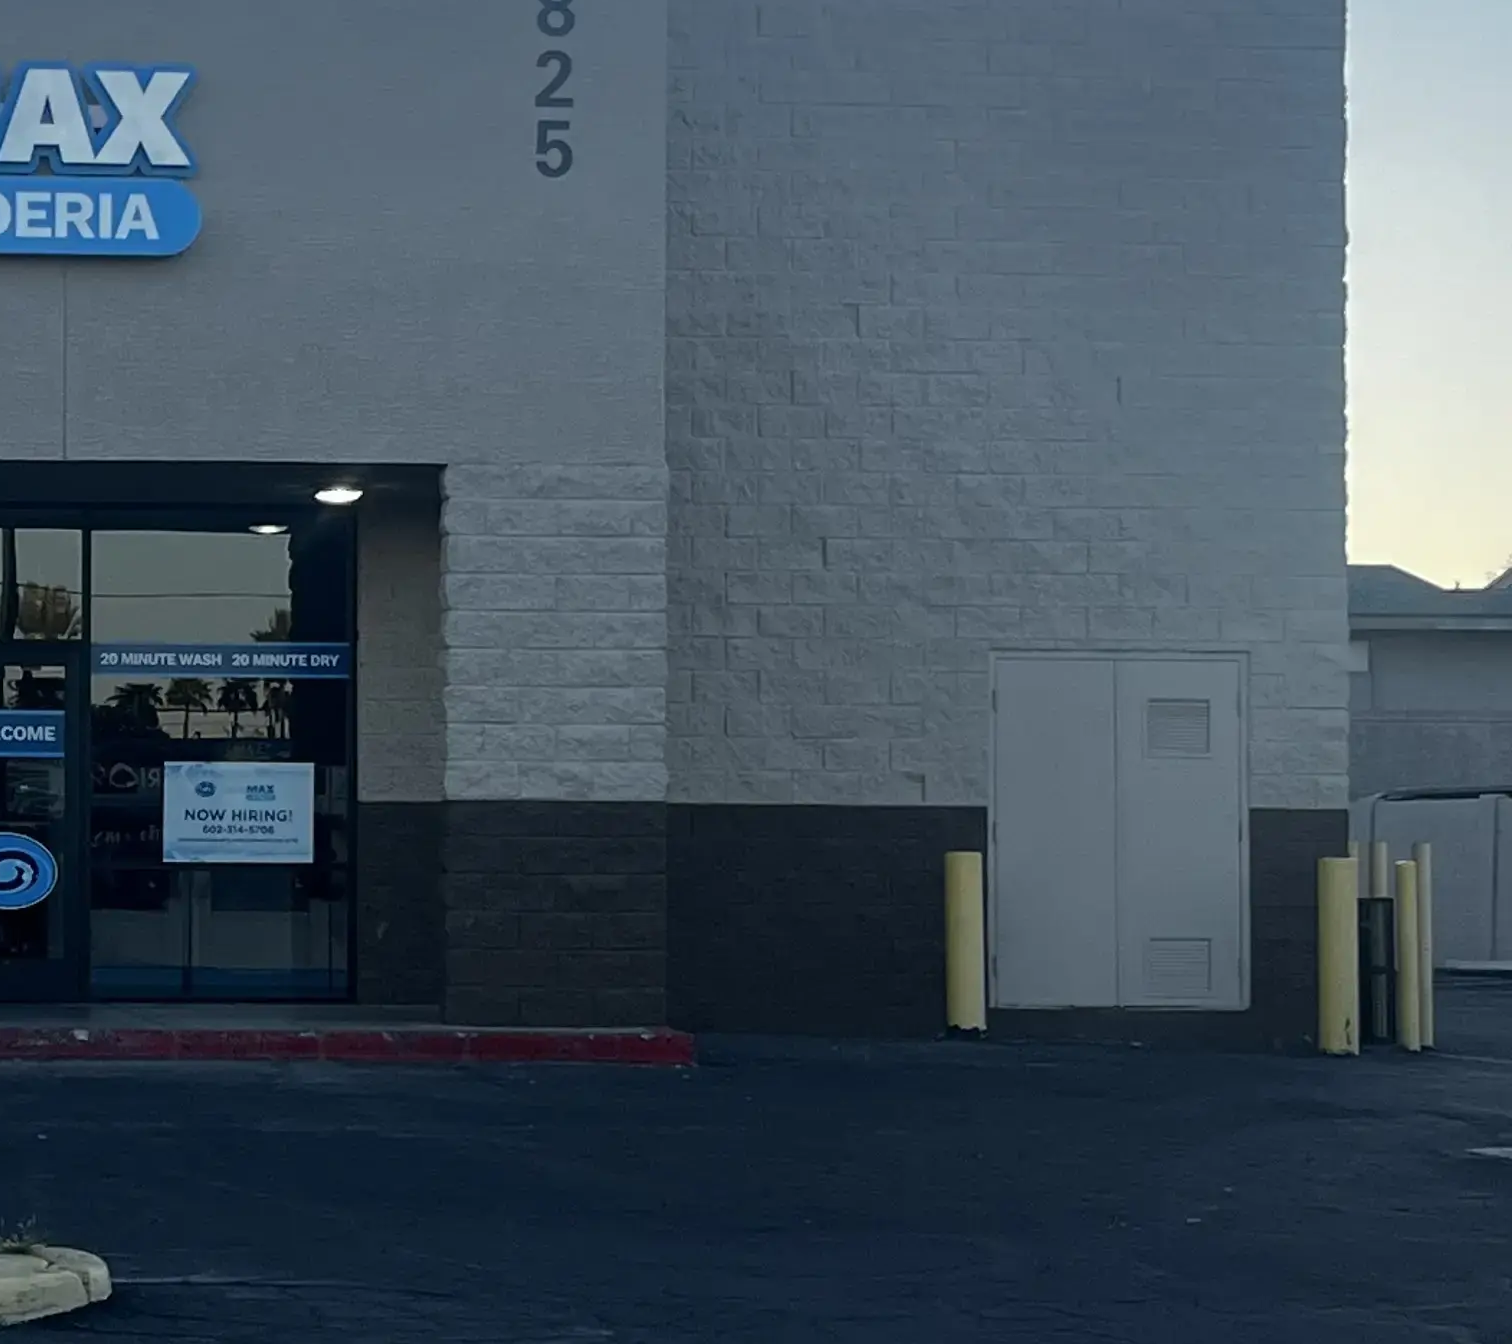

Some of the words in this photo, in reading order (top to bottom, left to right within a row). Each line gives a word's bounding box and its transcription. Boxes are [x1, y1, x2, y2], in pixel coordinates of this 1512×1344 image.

[99, 652, 120, 666] 20
[120, 653, 177, 666] MINUTE
[178, 653, 222, 667] WASH
[232, 653, 250, 667] 20
[252, 654, 308, 667] MINUTE
[310, 654, 340, 668] DRY
[246, 785, 275, 794] MAX
[184, 808, 227, 822] NOW
[232, 808, 294, 823] HIRING!
